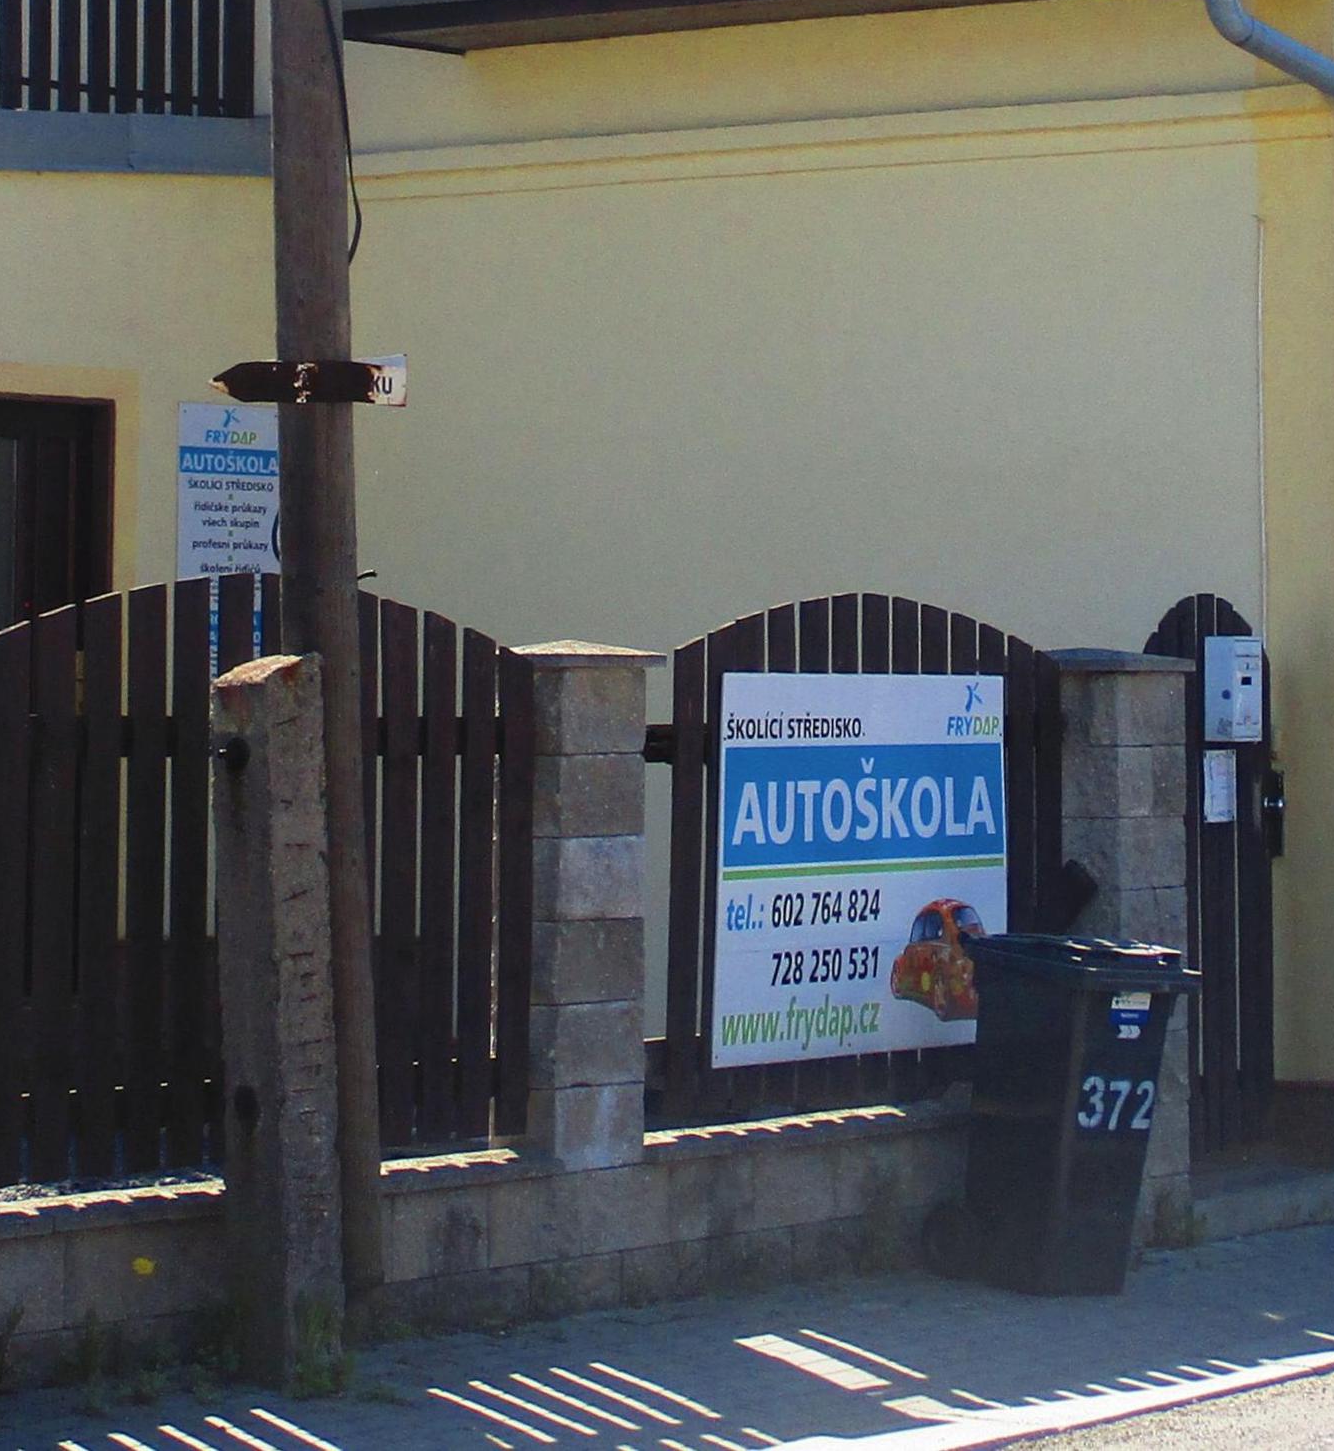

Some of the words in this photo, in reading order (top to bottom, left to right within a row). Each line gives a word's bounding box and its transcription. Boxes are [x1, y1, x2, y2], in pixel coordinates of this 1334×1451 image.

[204, 429, 257, 445] FRYDAP
[181, 449, 278, 475] AUTOŠKOLA
[225, 478, 275, 494] STŘEDISKO
[231, 502, 268, 519] průkazy
[201, 516, 228, 528] všech
[229, 518, 260, 532] skupin
[232, 539, 269, 555] průkazy
[725, 711, 784, 740] ŠKOLÍCÍ
[787, 713, 862, 740] STŘEDISKO
[946, 716, 999, 737] FRYDAP
[730, 757, 997, 847] AUTOŠKOLA
[725, 892, 765, 931] tel.:
[771, 892, 805, 928] 602
[810, 890, 843, 926] 764
[847, 889, 881, 923] 824
[770, 949, 805, 987] 728
[809, 947, 842, 984] 250
[847, 946, 880, 981] 531
[721, 994, 881, 1051] www.frydap.cz
[1077, 1075, 1156, 1131] 372
